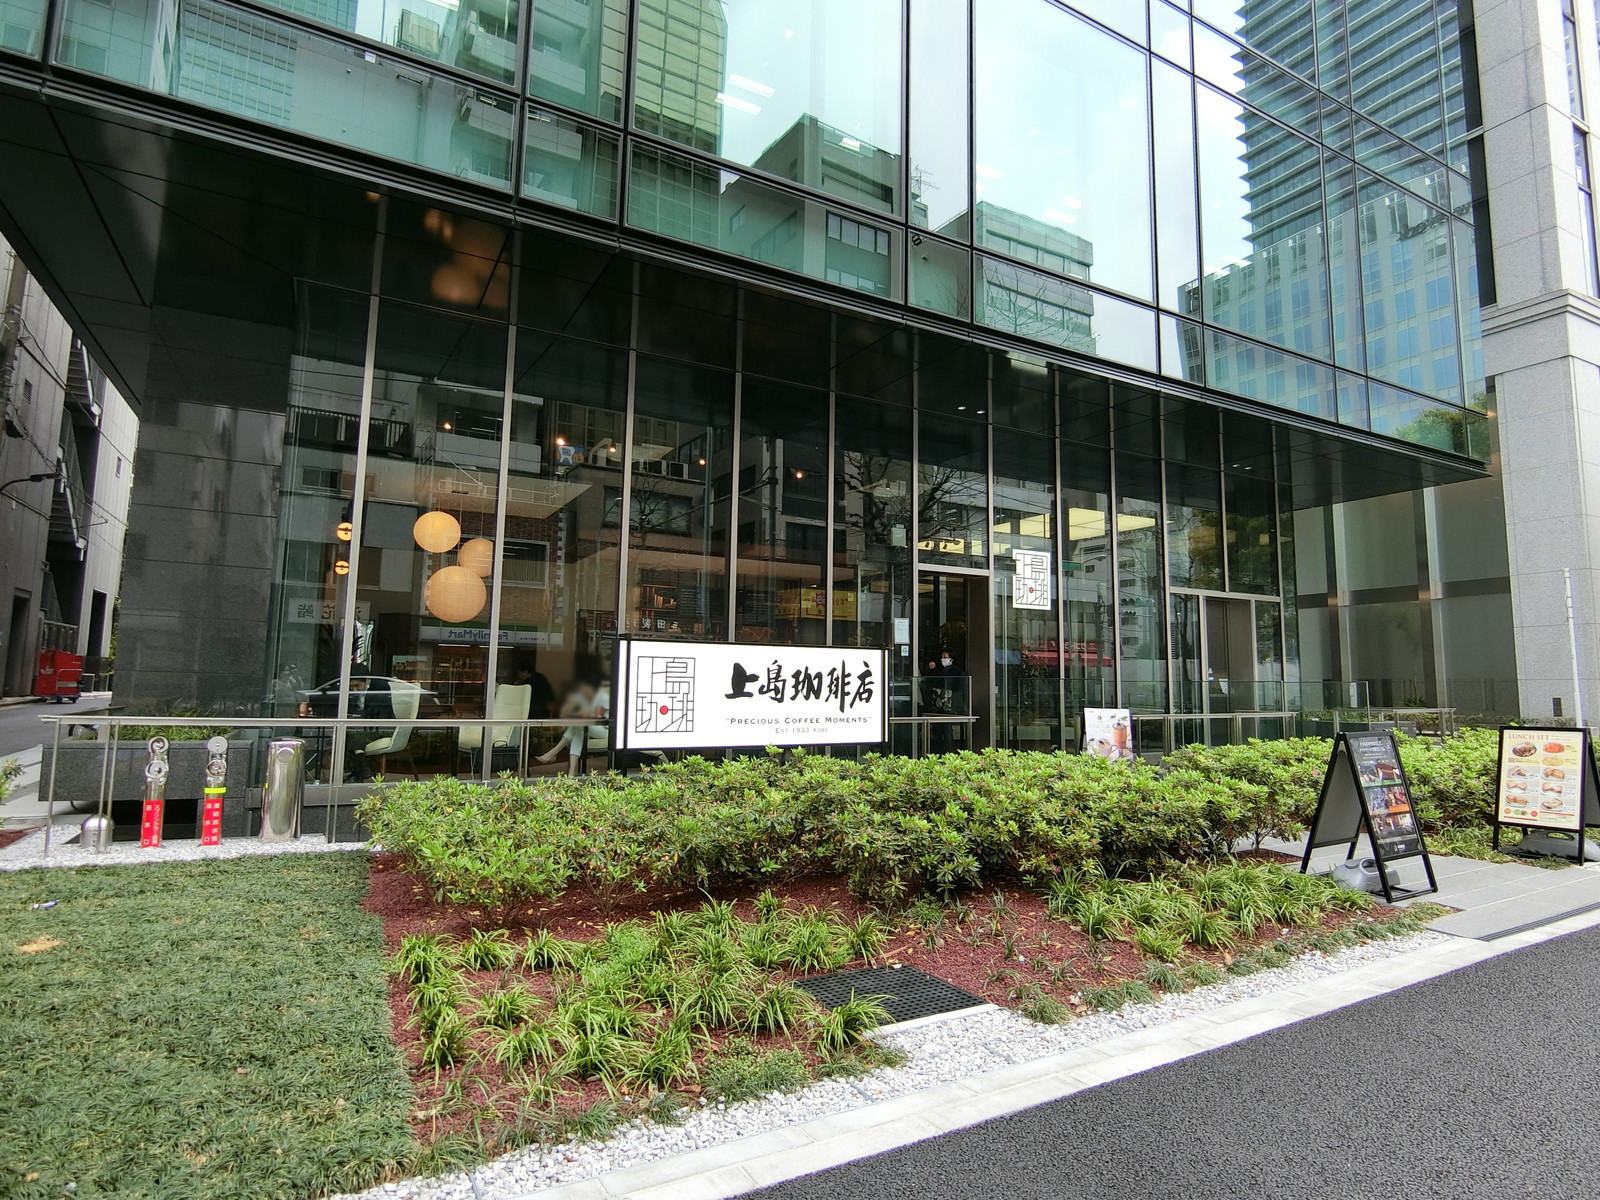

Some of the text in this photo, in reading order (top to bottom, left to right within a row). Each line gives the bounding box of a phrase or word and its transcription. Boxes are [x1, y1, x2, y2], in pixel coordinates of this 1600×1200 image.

[725, 659, 875, 713] 上島珈琲店
[1508, 733, 1535, 741] LUNCH
